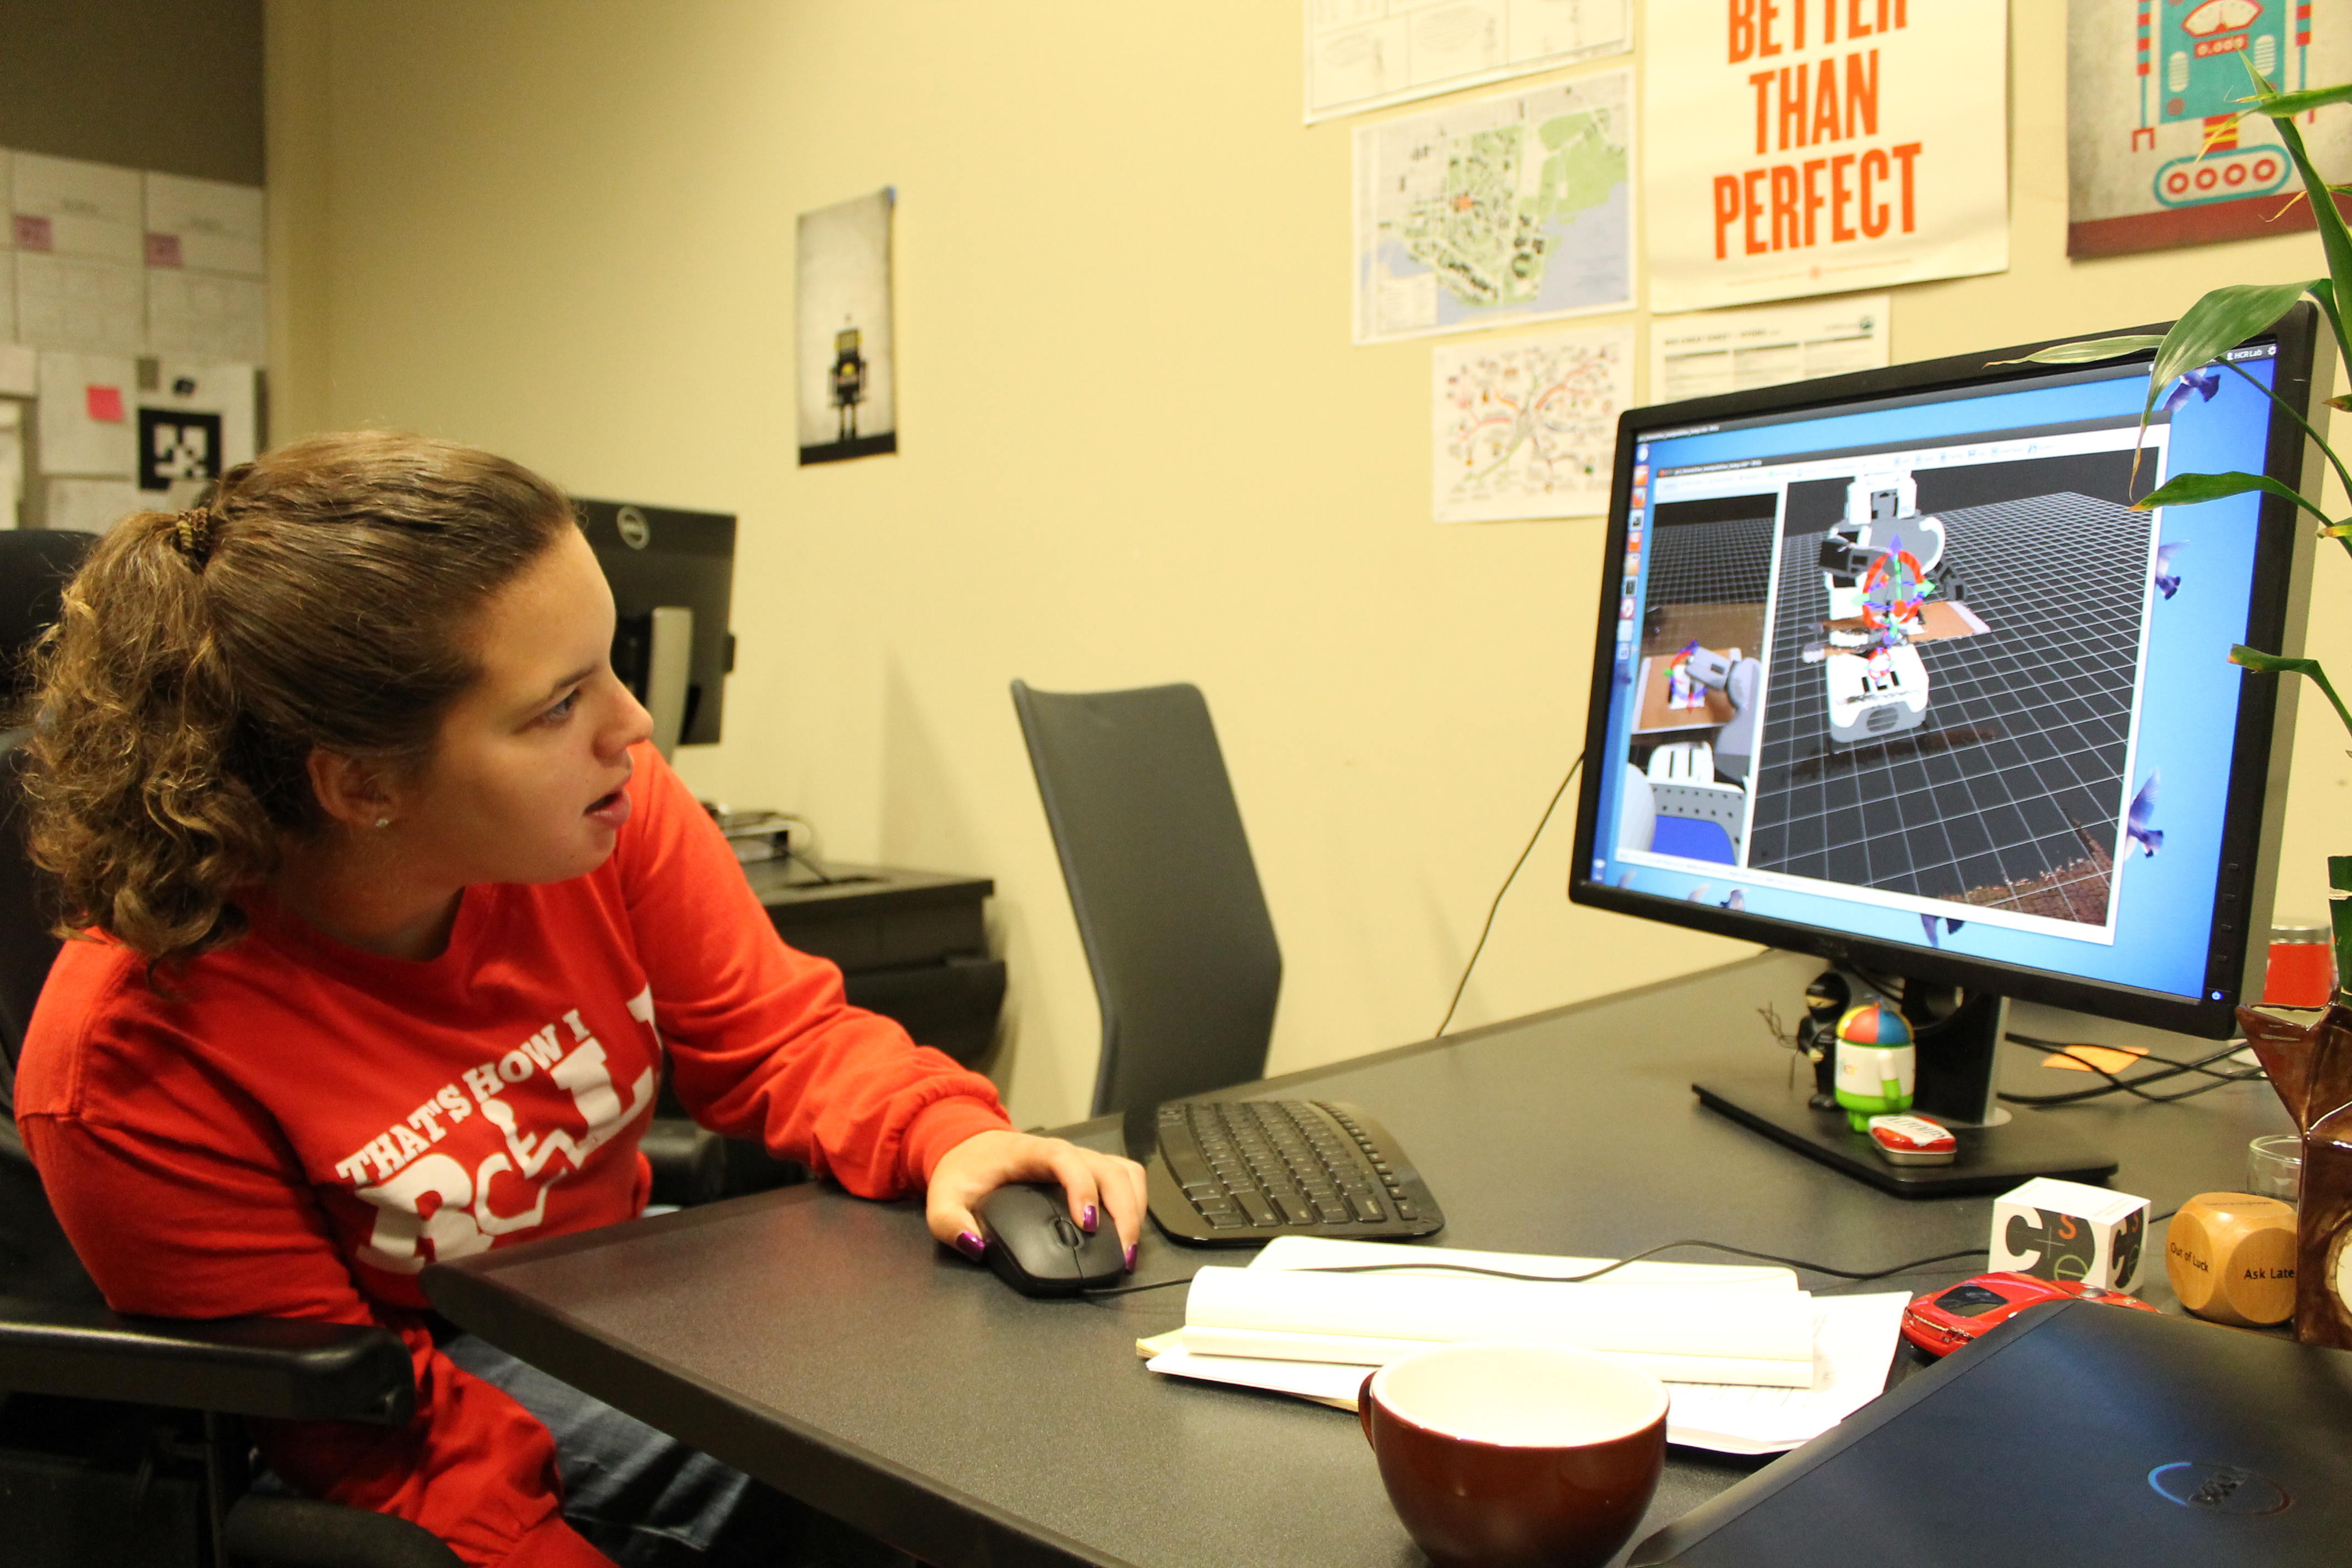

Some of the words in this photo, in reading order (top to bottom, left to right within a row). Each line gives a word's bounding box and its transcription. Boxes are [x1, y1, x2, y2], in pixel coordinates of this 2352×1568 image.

[1749, 48, 1880, 155] THAN
[1713, 141, 1923, 260] PERFECT
[2234, 351, 2248, 359] HCR
[2249, 349, 2262, 357] Lab
[335, 1083, 473, 1185] THAT'S
[462, 1022, 563, 1103] HOW
[562, 1008, 591, 1042] I
[2170, 1242, 2183, 1258] Out
[2184, 1251, 2192, 1262] of
[2193, 1254, 2209, 1273] Luck
[2244, 1267, 2266, 1280] Ask
